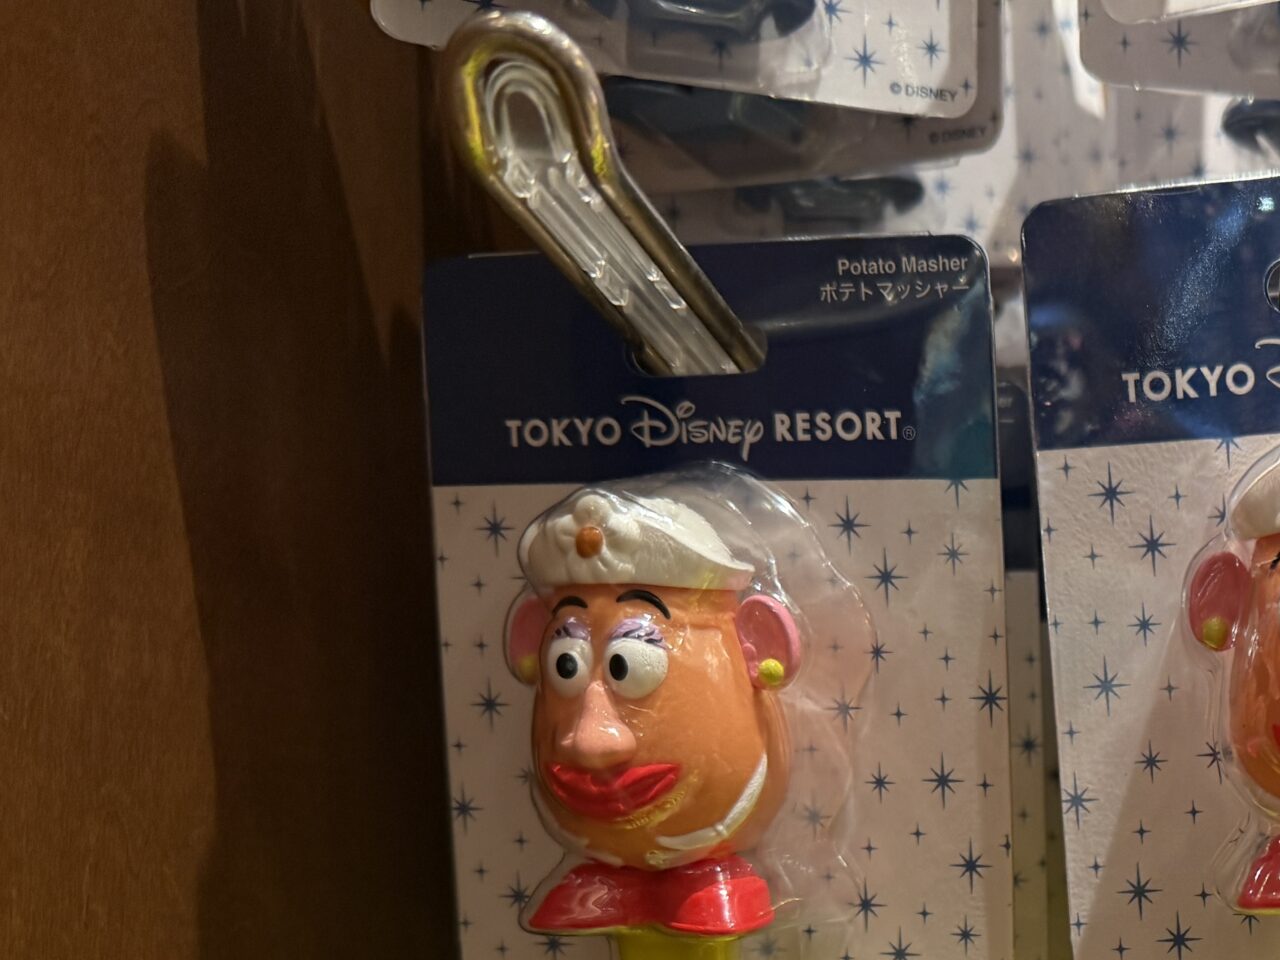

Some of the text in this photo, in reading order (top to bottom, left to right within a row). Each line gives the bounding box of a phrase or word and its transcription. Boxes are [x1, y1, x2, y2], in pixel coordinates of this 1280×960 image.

[905, 84, 957, 102] DISNEY
[838, 255, 968, 275] Potato Masher
[820, 280, 970, 303] ポテトマッシャー
[1122, 363, 1256, 403] TOKYO
[505, 417, 622, 447] TOKYO
[620, 396, 764, 462] Disney
